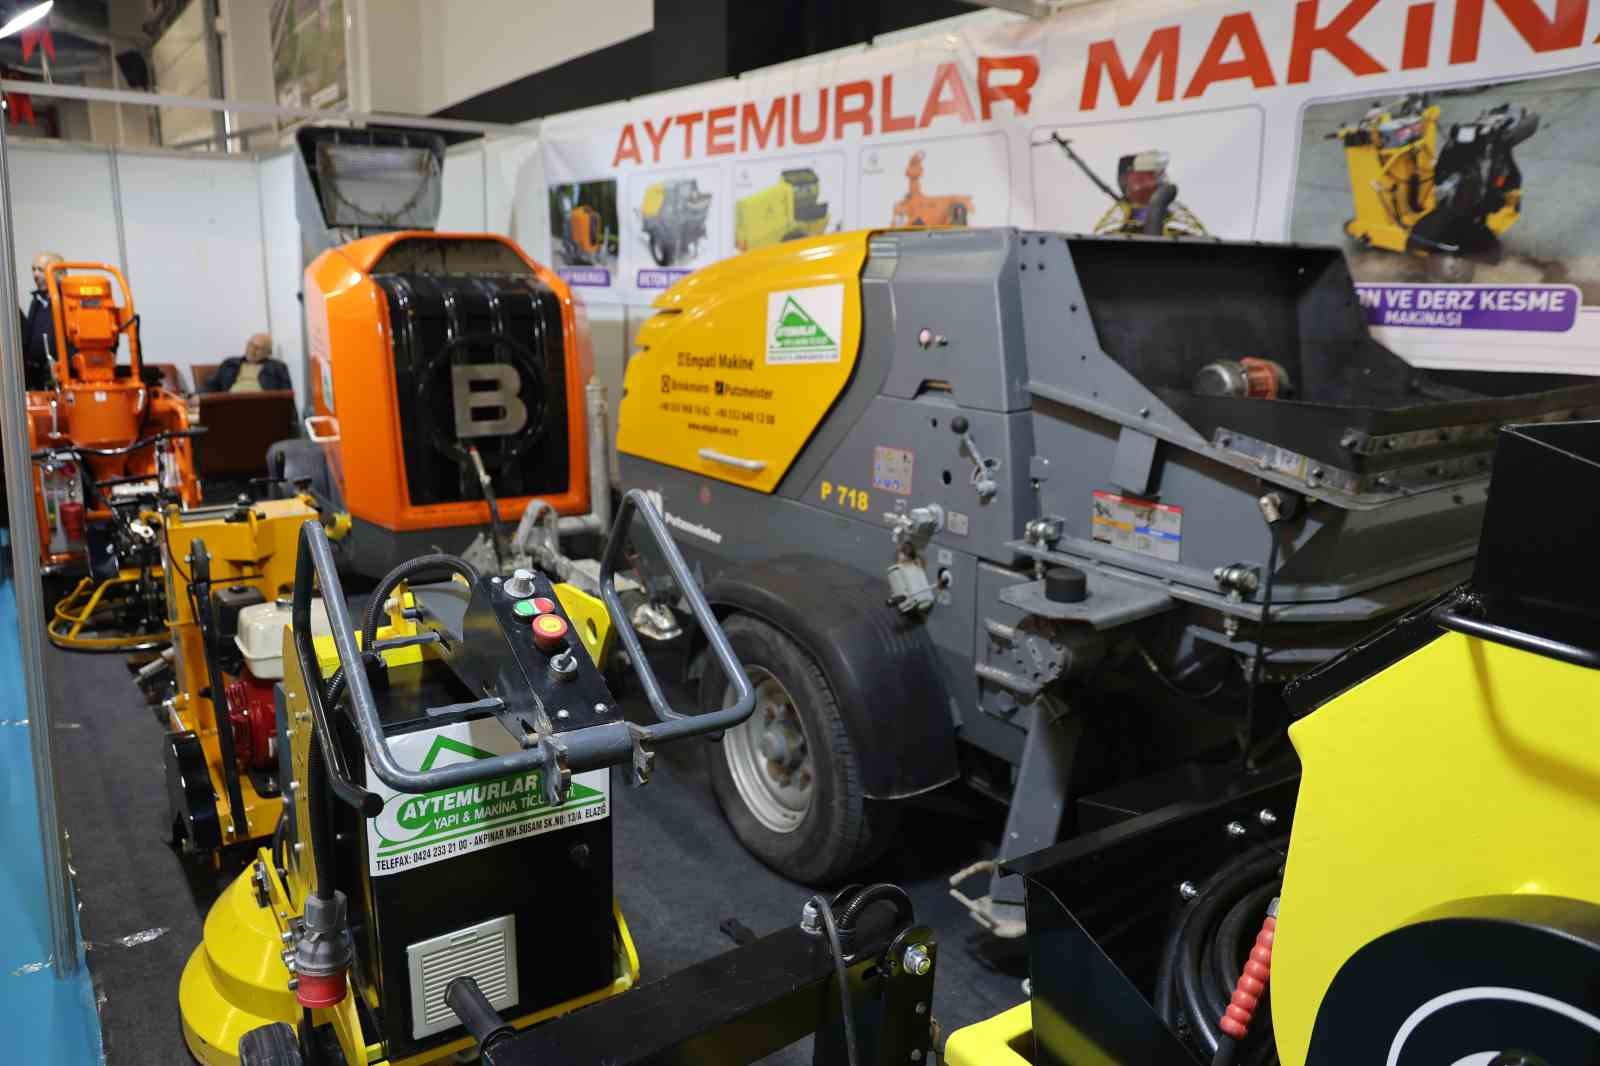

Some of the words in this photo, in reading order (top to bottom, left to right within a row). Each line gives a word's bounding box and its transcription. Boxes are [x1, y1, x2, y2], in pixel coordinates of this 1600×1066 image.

[612, 54, 1040, 168] AYTEMURLAR
[1079, 0, 1600, 111] MAKİN
[1384, 289, 1413, 309] VE
[1416, 290, 1476, 311] DERZ
[1479, 290, 1567, 312] KESME
[718, 353, 754, 371] Makine
[452, 363, 527, 438] B
[820, 481, 833, 500] P
[837, 486, 870, 512] 718
[402, 774, 538, 821] AYTEMURLAR
[433, 815, 459, 831] YAPI
[462, 810, 471, 823] &
[376, 855, 412, 871] TELEFAX:
[413, 849, 431, 863] 0424
[433, 846, 447, 858] 233
[448, 842, 456, 854] 21
[459, 840, 468, 851] 00
[474, 831, 504, 848] AKPINAR
